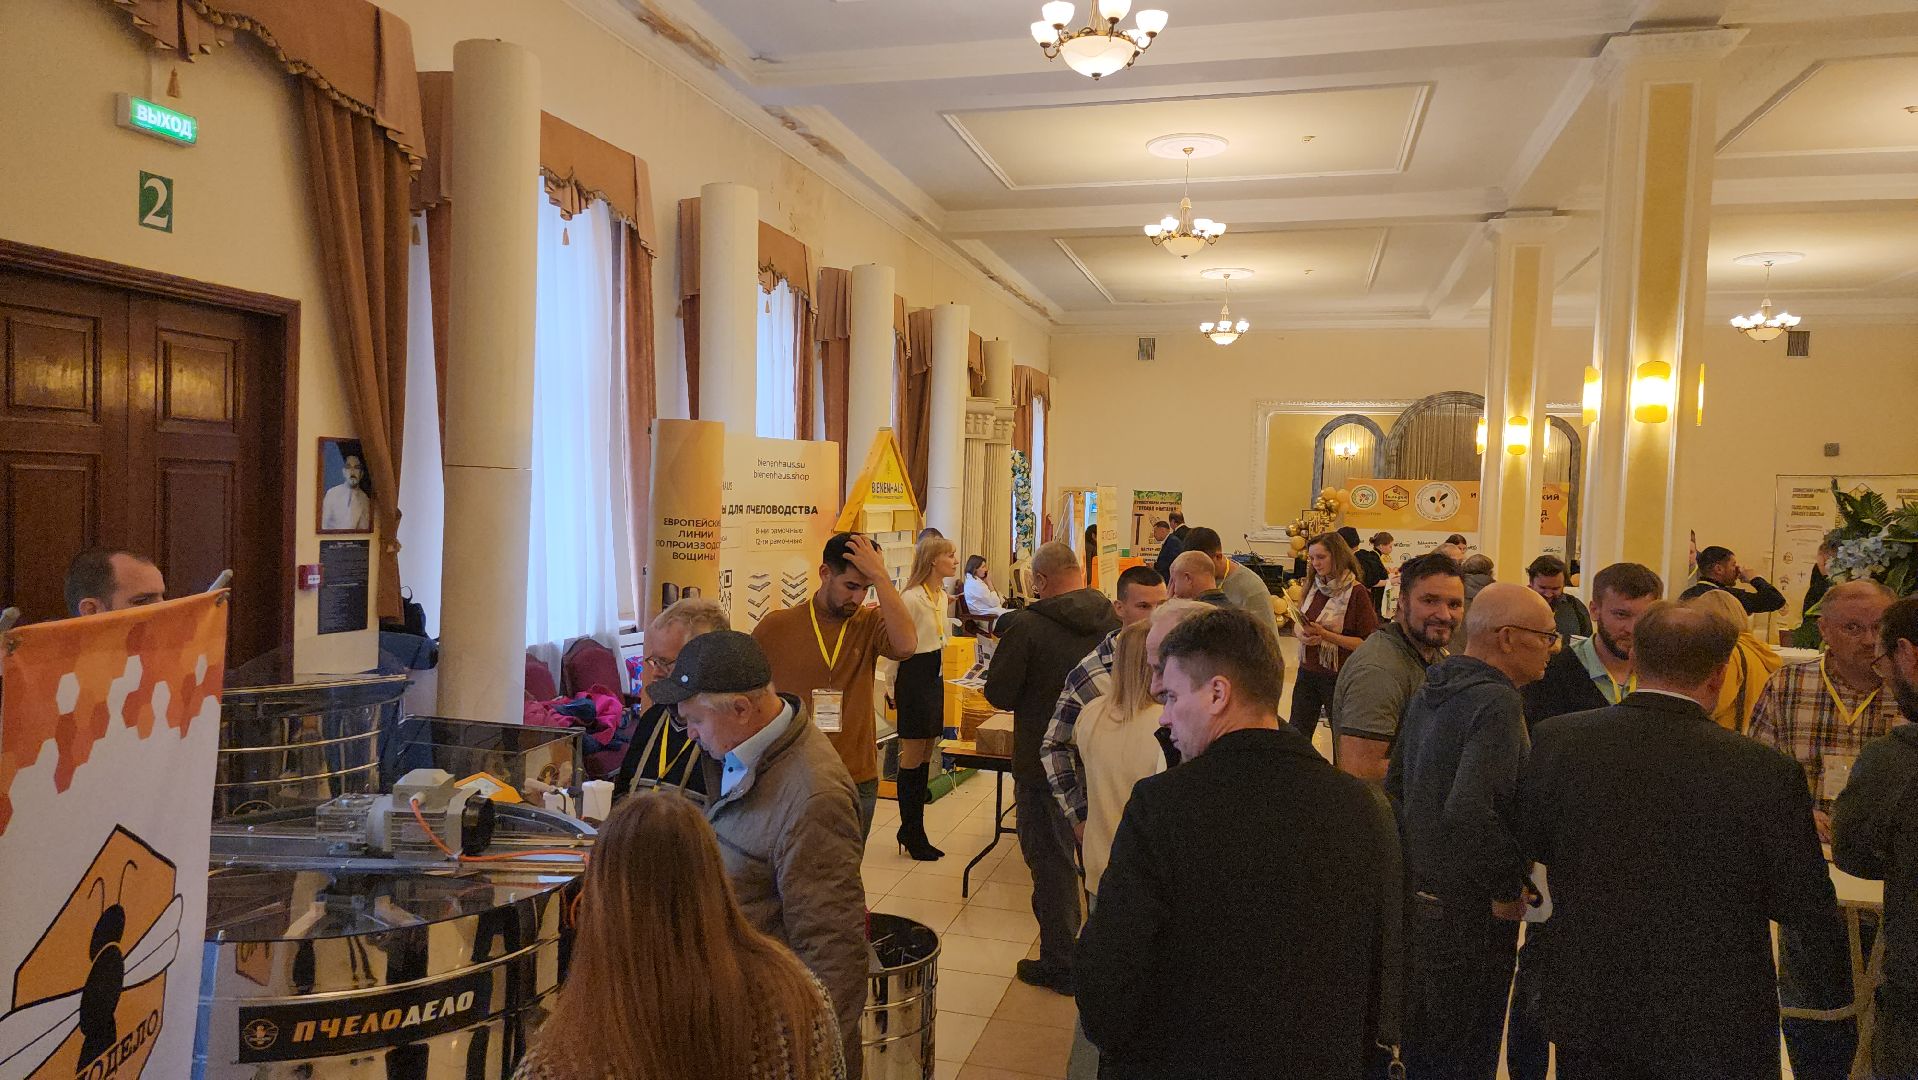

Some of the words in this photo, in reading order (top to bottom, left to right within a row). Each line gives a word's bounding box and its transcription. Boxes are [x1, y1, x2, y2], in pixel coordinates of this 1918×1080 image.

[136, 103, 193, 140] ВЫХОД
[142, 177, 170, 228] 2
[728, 504, 744, 516] ДЛЯ
[745, 504, 819, 517] ПЧЕЛОВОДСТВА
[663, 517, 721, 528] ЕВРОПЕЙСКИ
[678, 530, 714, 539] ЛИНИИ
[672, 551, 716, 562] ВОЩИНЫ
[291, 990, 475, 1043] ПЧЕЛОДЕЛО
